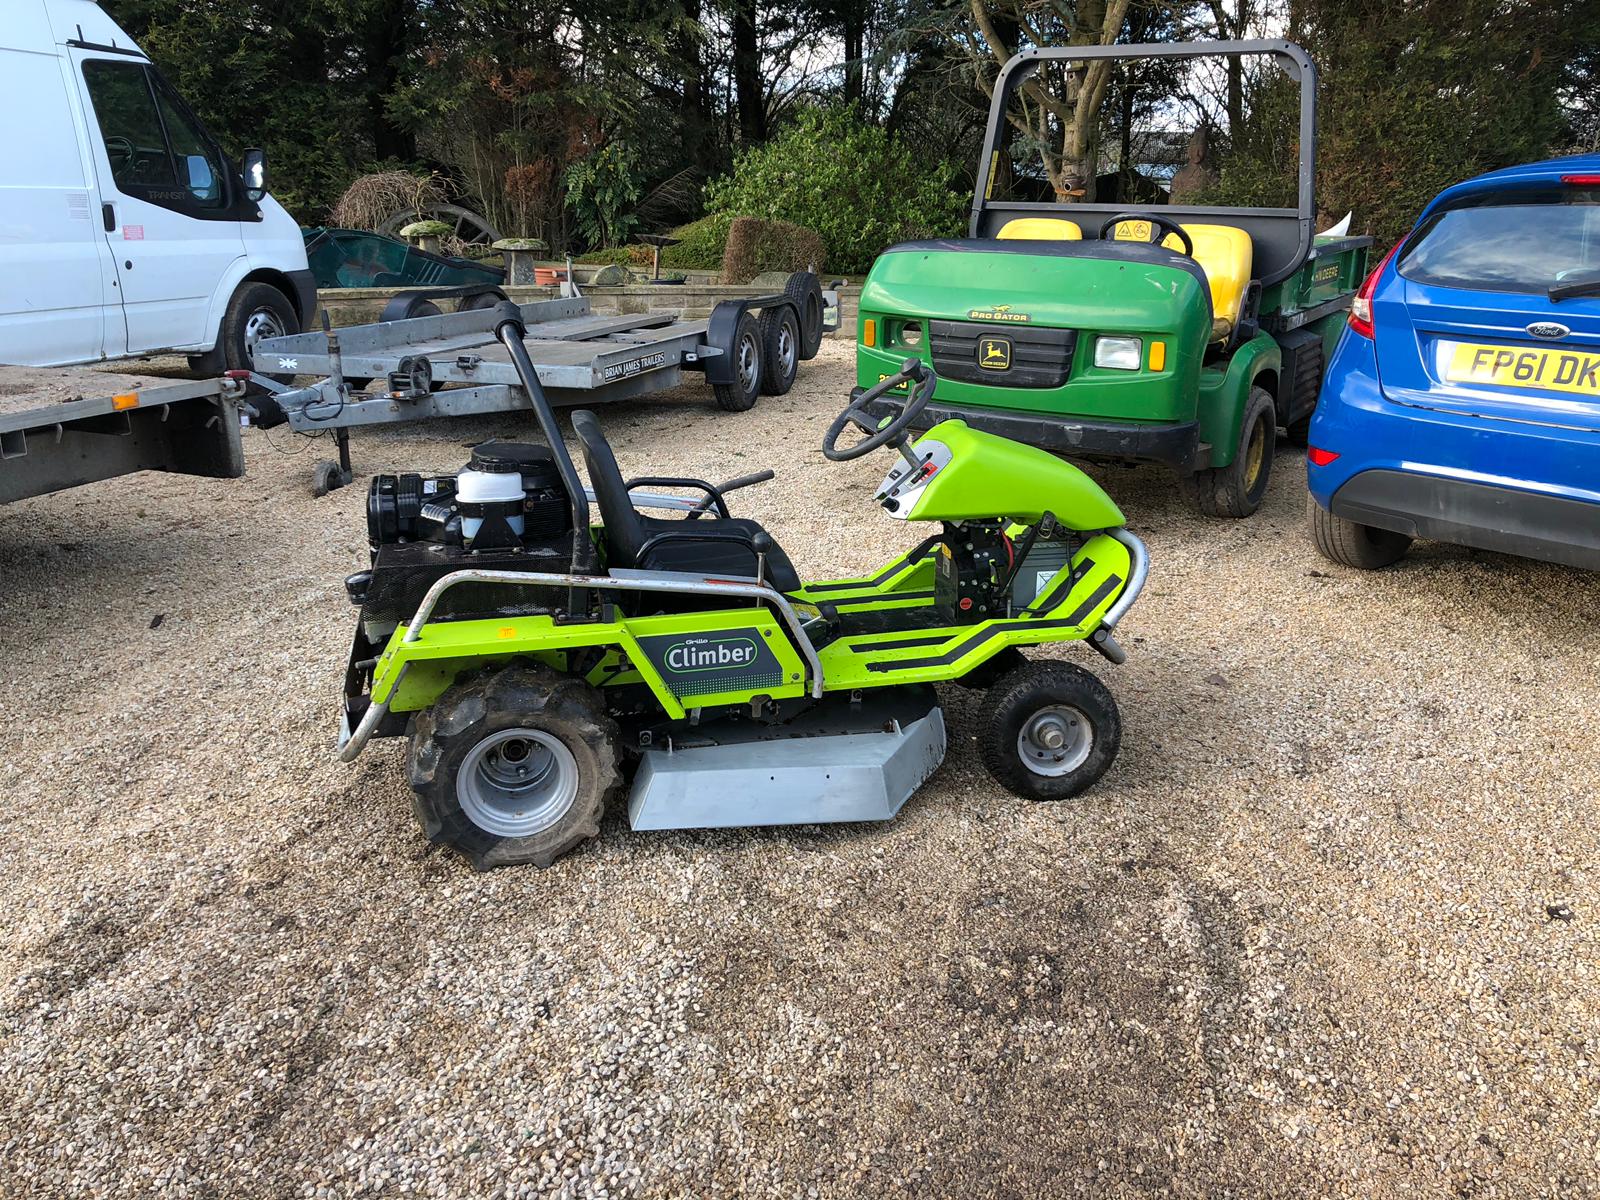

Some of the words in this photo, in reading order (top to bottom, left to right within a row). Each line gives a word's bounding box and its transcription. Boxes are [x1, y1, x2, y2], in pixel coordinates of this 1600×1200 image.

[971, 311, 992, 320] PRO
[993, 312, 1027, 321] GATOR
[1534, 325, 1560, 336] Ford
[605, 364, 623, 378] BRIAN
[622, 359, 641, 375] JAMES
[641, 352, 665, 368] TRAILERS
[1471, 349, 1548, 382] FP61
[1552, 355, 1600, 388] DK
[668, 644, 753, 668] Climber
